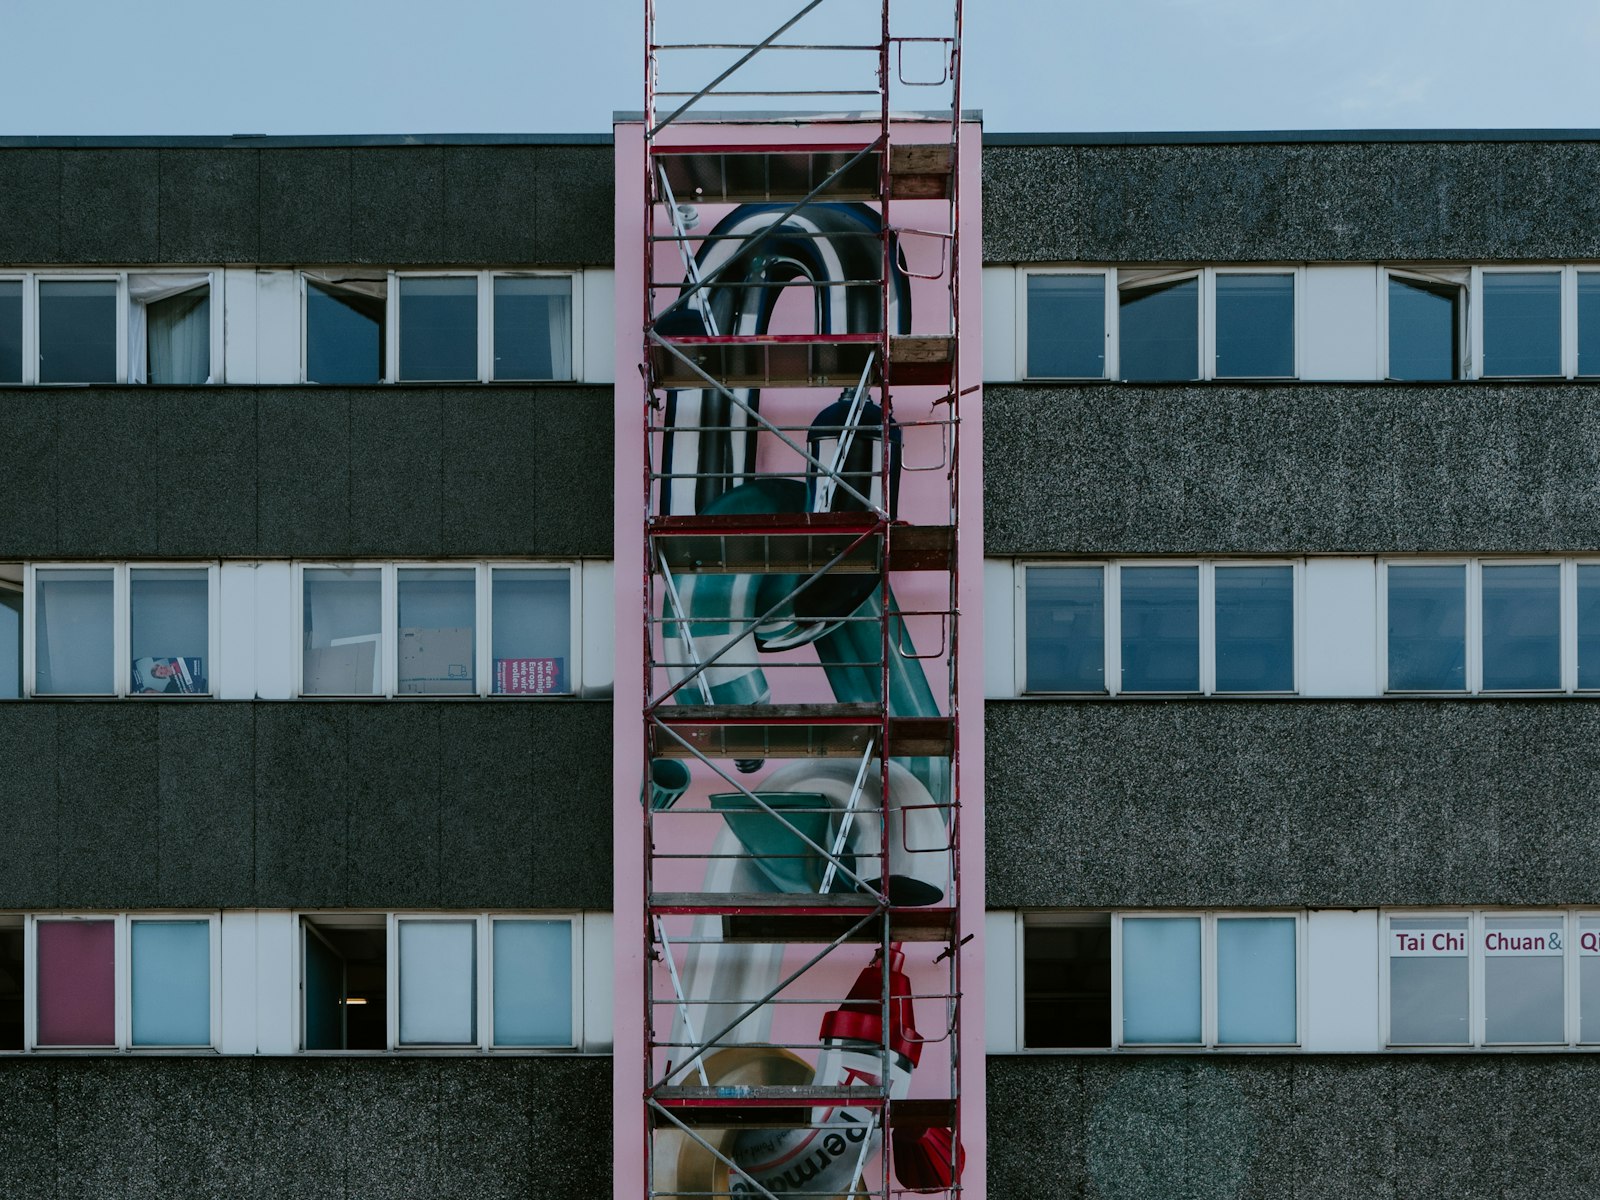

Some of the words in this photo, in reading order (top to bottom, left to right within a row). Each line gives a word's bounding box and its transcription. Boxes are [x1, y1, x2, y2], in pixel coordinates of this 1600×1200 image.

[512, 661, 520, 690] wollen.
[528, 661, 536, 690] Europa
[1397, 933, 1425, 951] Tai
[1432, 933, 1465, 951] Chi
[1485, 933, 1545, 950] Chuan
[1548, 932, 1563, 950] &
